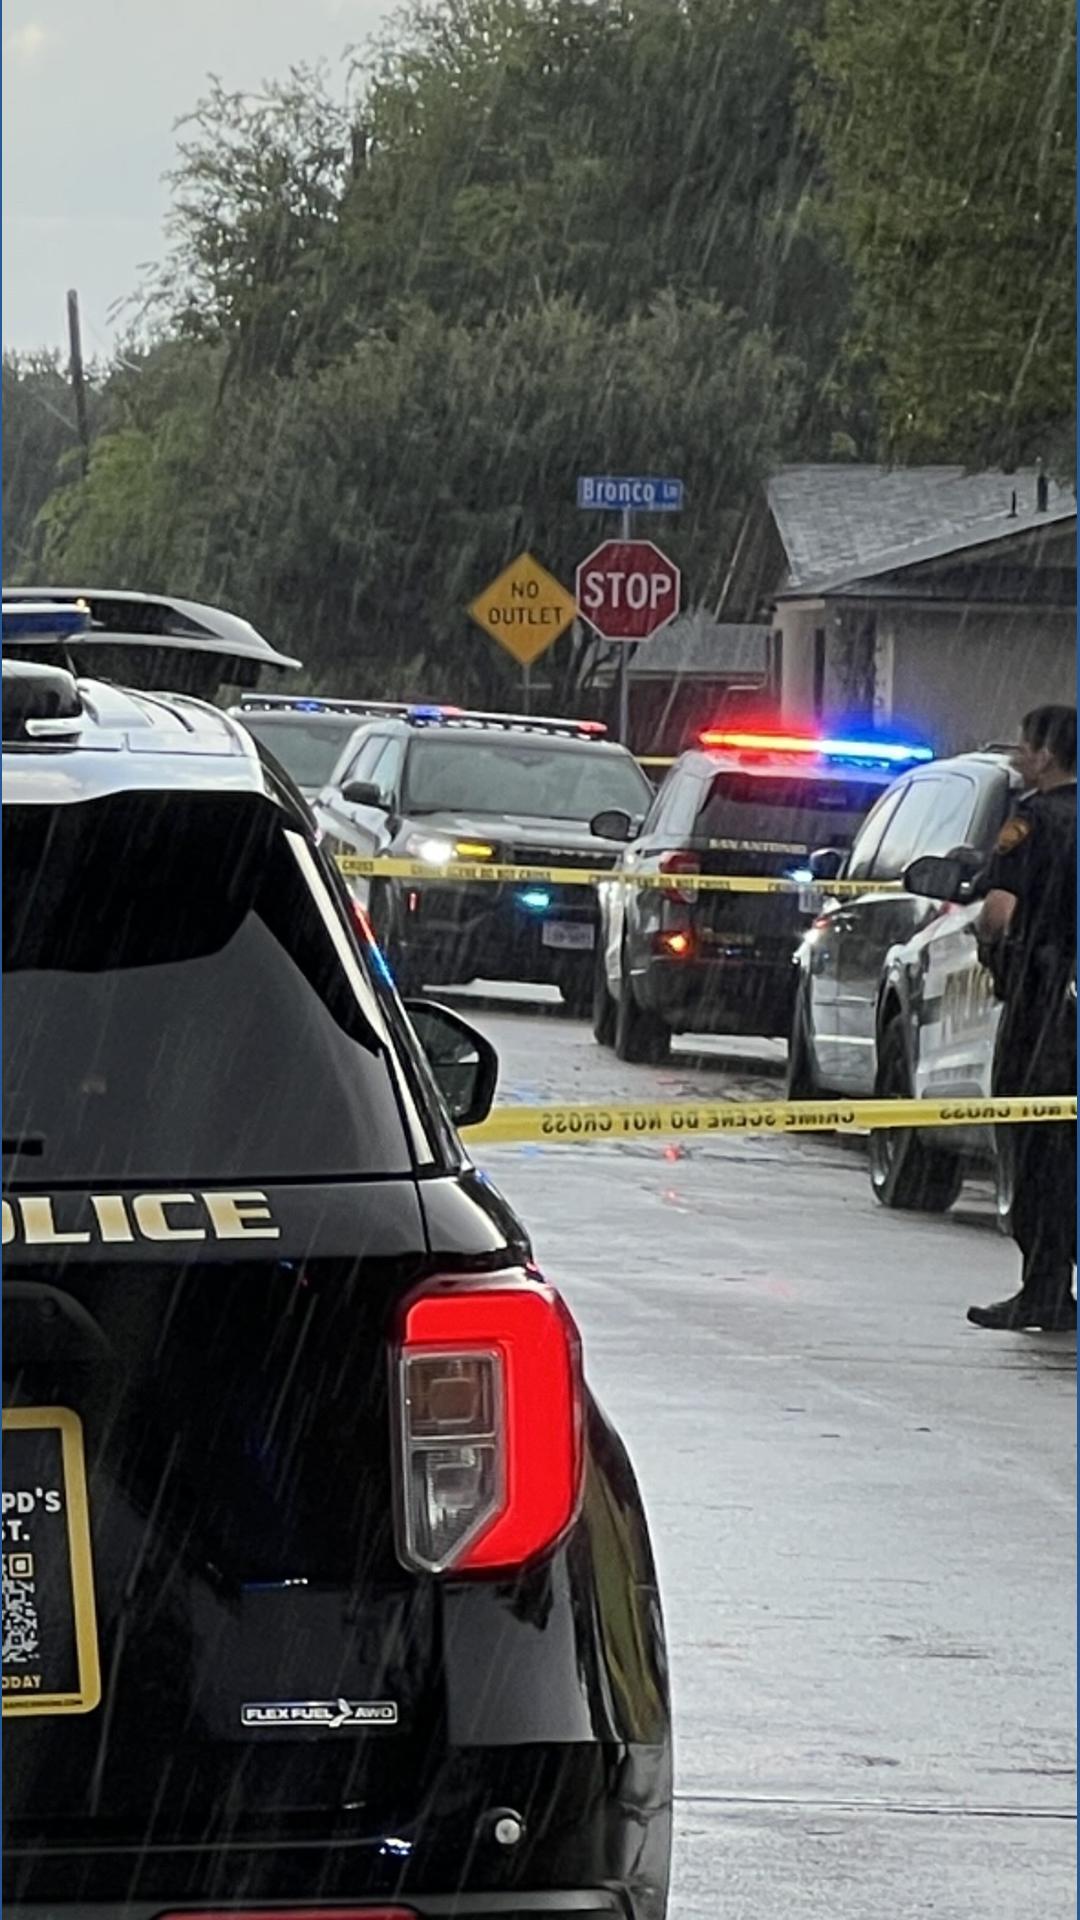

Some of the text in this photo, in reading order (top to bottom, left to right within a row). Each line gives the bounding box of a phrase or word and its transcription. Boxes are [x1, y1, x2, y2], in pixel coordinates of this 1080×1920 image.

[583, 477, 655, 502] Bronco
[511, 580, 539, 599] NO
[584, 571, 672, 610] STOP
[488, 606, 563, 625] OUTLET
[246, 1707, 393, 1720] FLEX FUEL AWD
